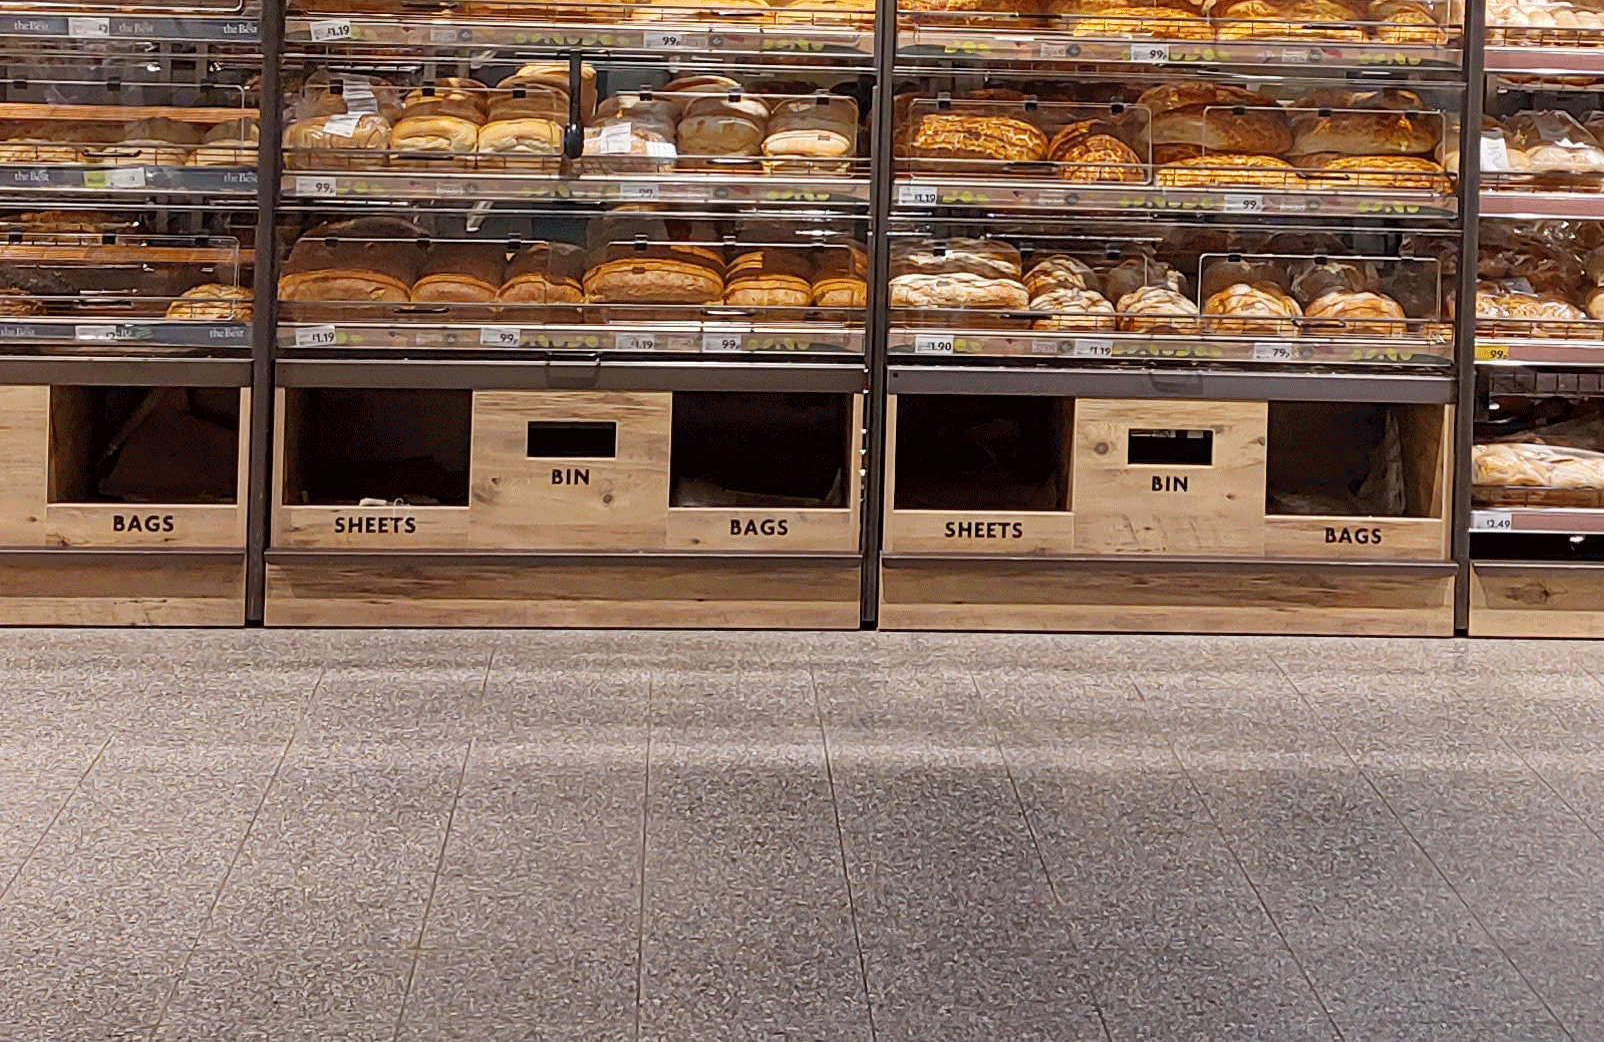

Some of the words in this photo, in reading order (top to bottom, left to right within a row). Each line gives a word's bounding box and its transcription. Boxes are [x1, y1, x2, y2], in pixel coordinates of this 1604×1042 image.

[313, 333, 334, 343] £1.19
[551, 468, 590, 486] BIN
[1151, 475, 1189, 493] BIN
[113, 515, 175, 533] BAGS
[334, 516, 417, 534] SHEETS
[730, 518, 789, 537] BAGS
[944, 520, 1024, 540] SHEETS
[1324, 526, 1383, 546] BAGS
